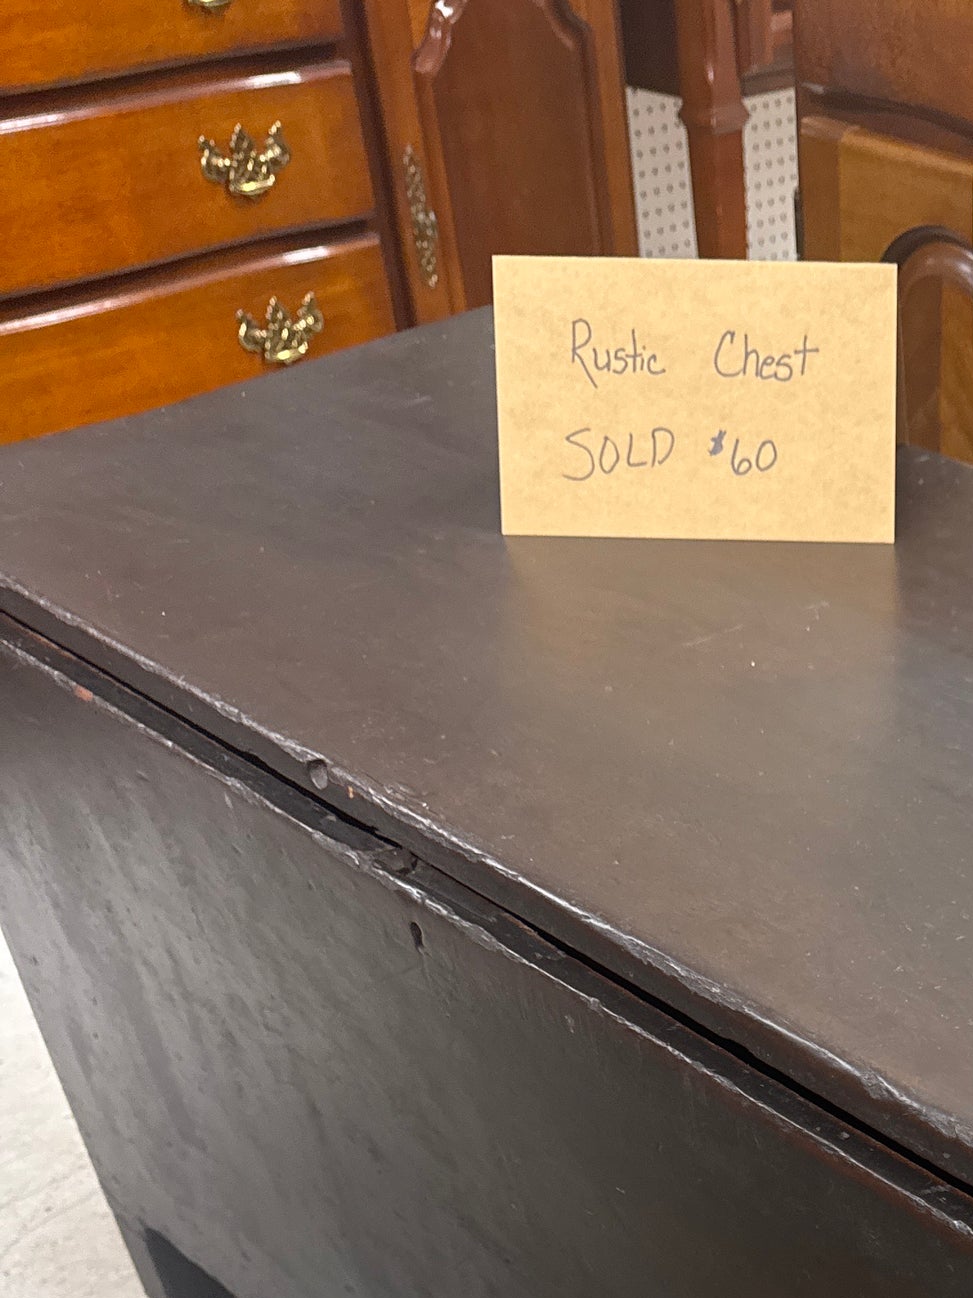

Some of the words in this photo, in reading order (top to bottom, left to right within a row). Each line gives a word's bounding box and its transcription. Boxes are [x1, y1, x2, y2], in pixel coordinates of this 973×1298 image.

[571, 318, 666, 389] Rustic
[713, 329, 820, 382] Chest
[562, 427, 675, 482] SOLD
[707, 429, 778, 476] $60
